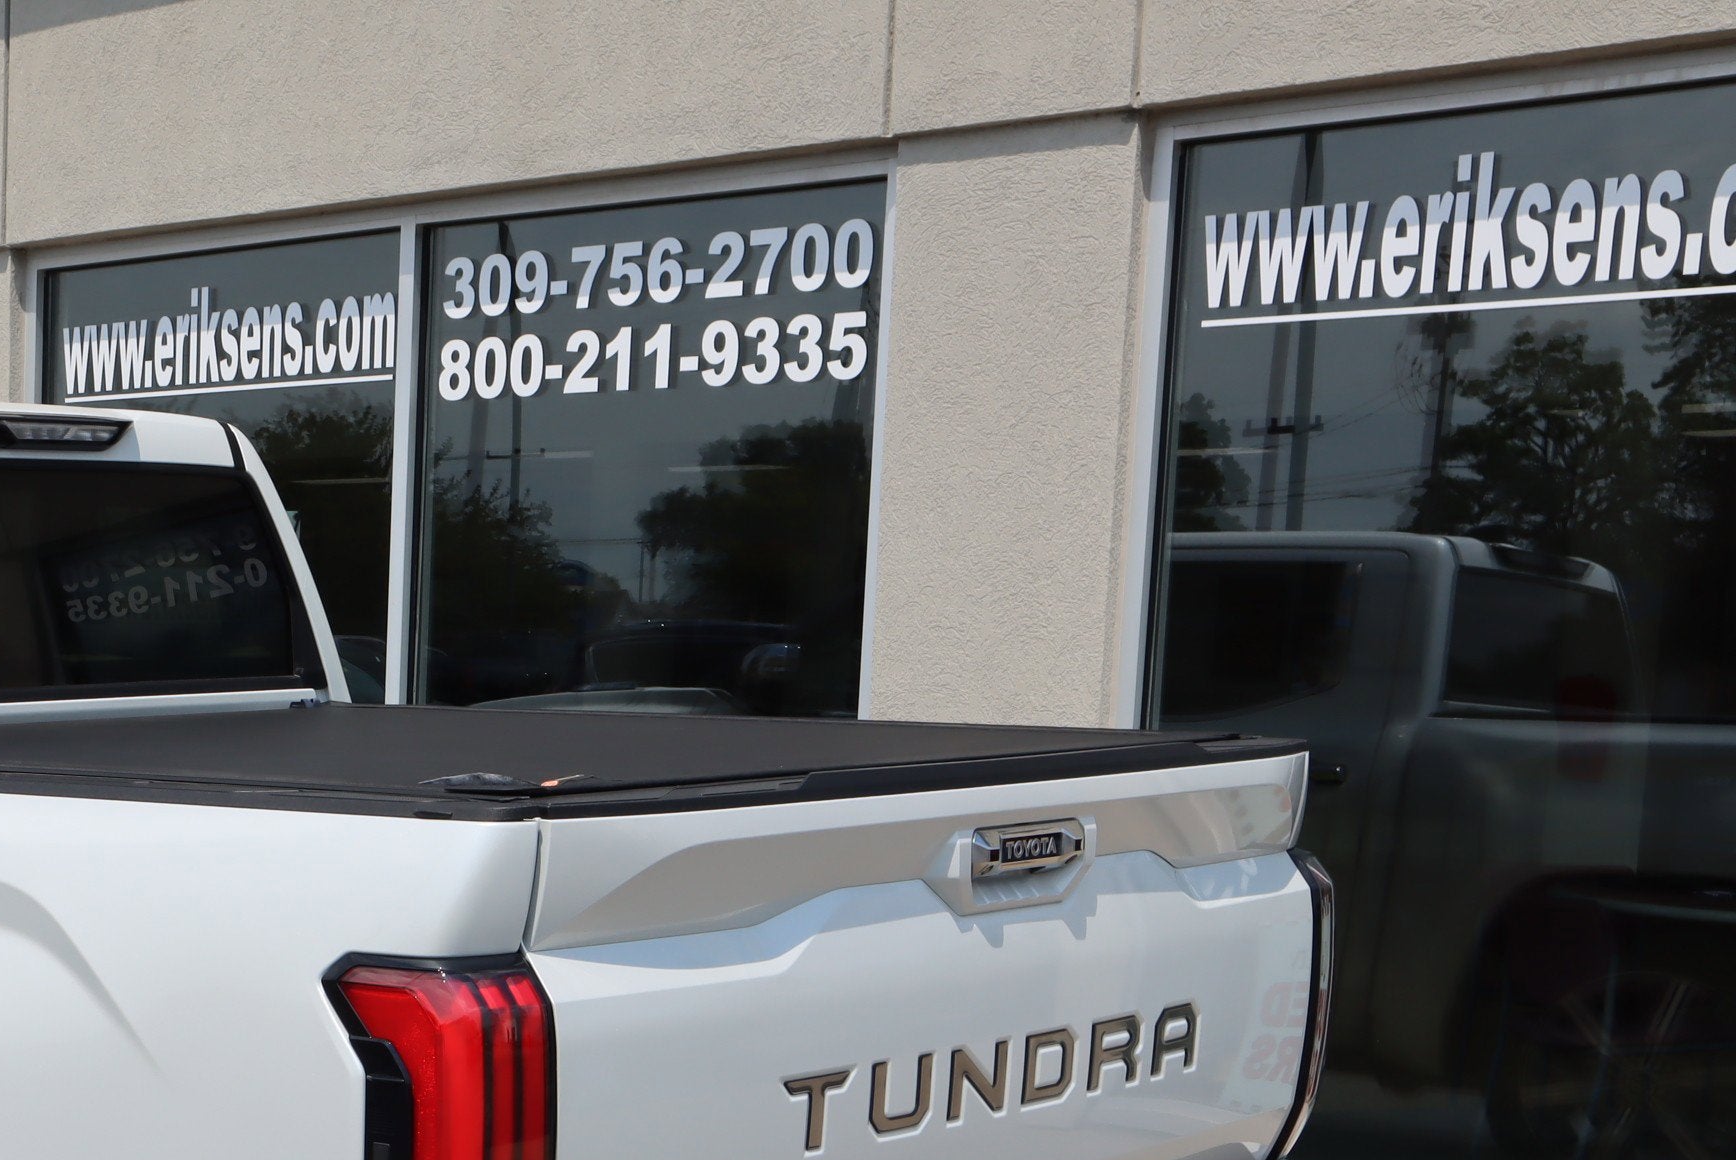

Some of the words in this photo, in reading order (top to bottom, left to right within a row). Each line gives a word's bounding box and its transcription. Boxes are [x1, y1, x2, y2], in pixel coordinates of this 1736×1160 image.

[442, 218, 874, 320] 309-756-2700
[63, 286, 397, 395] www.eriksens.com
[438, 310, 869, 402] 800-211-9335
[1005, 836, 1057, 860] TOYOTA
[782, 1000, 1199, 1153] TUNDRA
